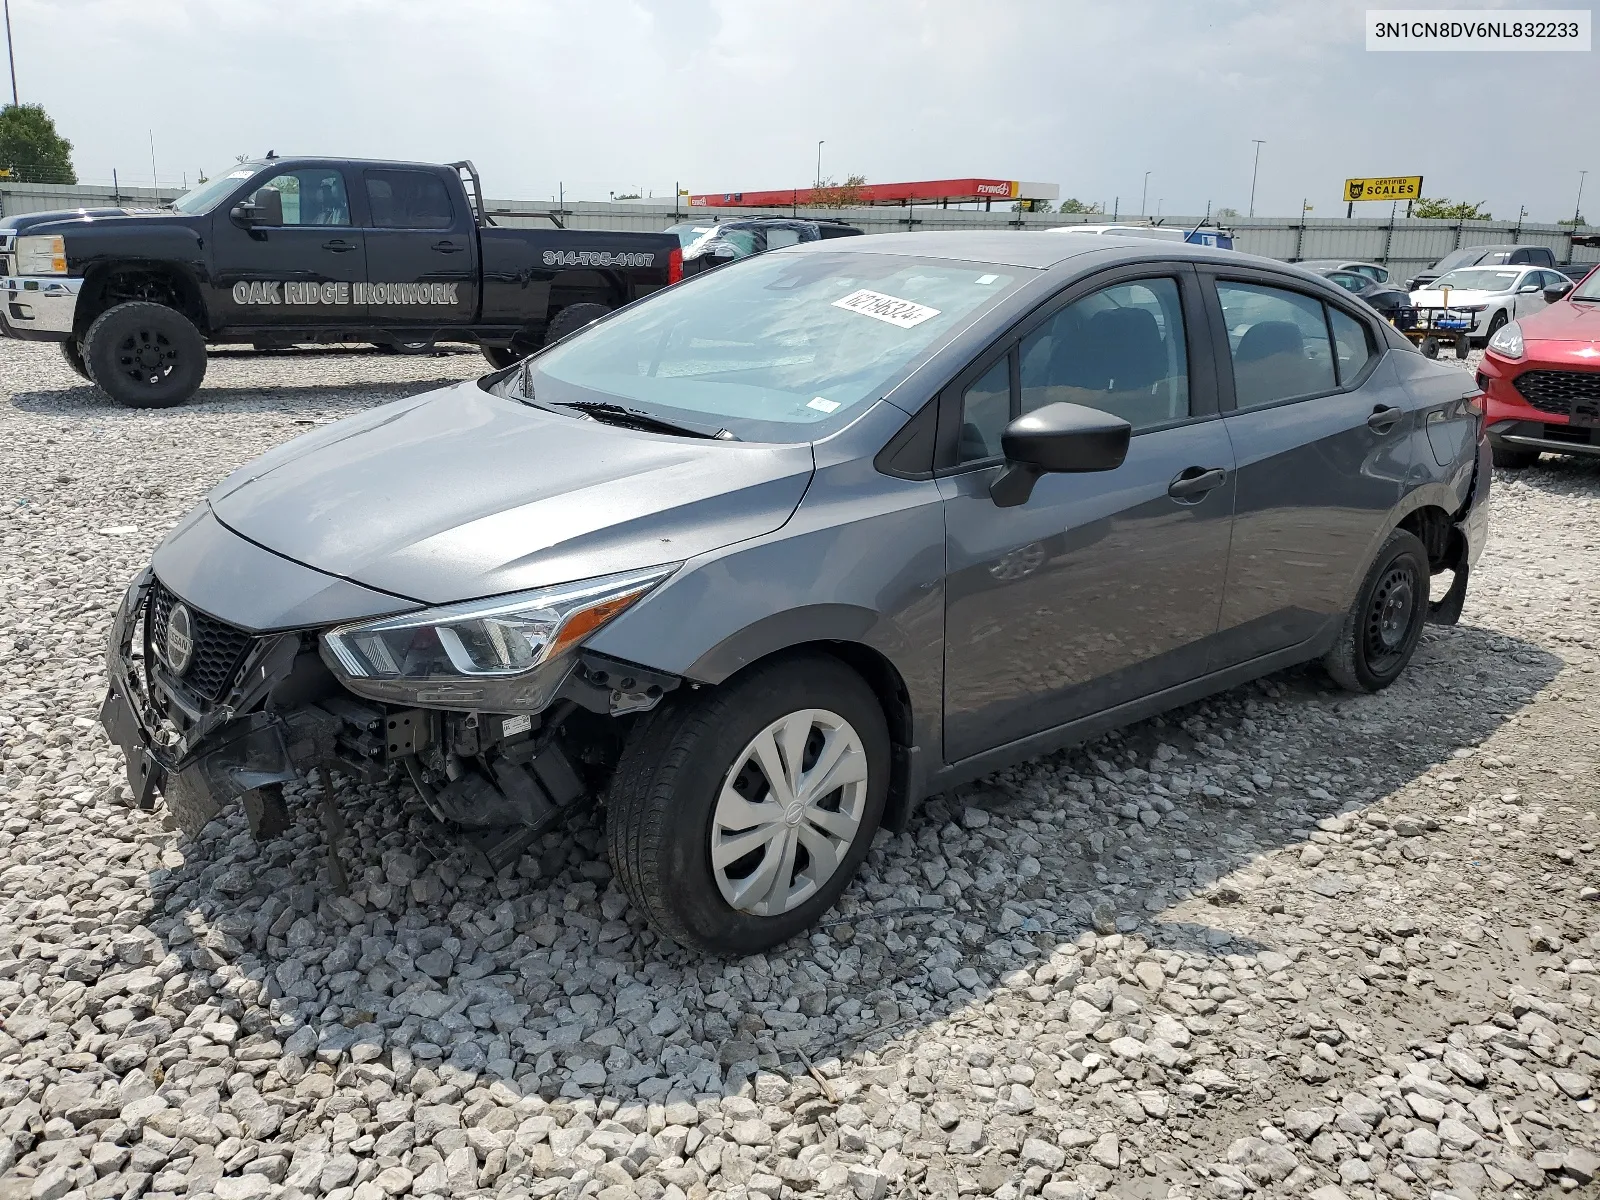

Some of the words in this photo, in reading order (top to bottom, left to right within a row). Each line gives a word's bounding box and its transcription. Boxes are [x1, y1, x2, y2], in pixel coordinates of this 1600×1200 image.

[1375, 178, 1407, 186] CERTIFIED
[1366, 185, 1414, 195] SCALES
[542, 250, 655, 267] 314-795-4107
[232, 280, 282, 305] OAK
[284, 281, 350, 305] RIDGE
[353, 282, 459, 305] IRONWORK
